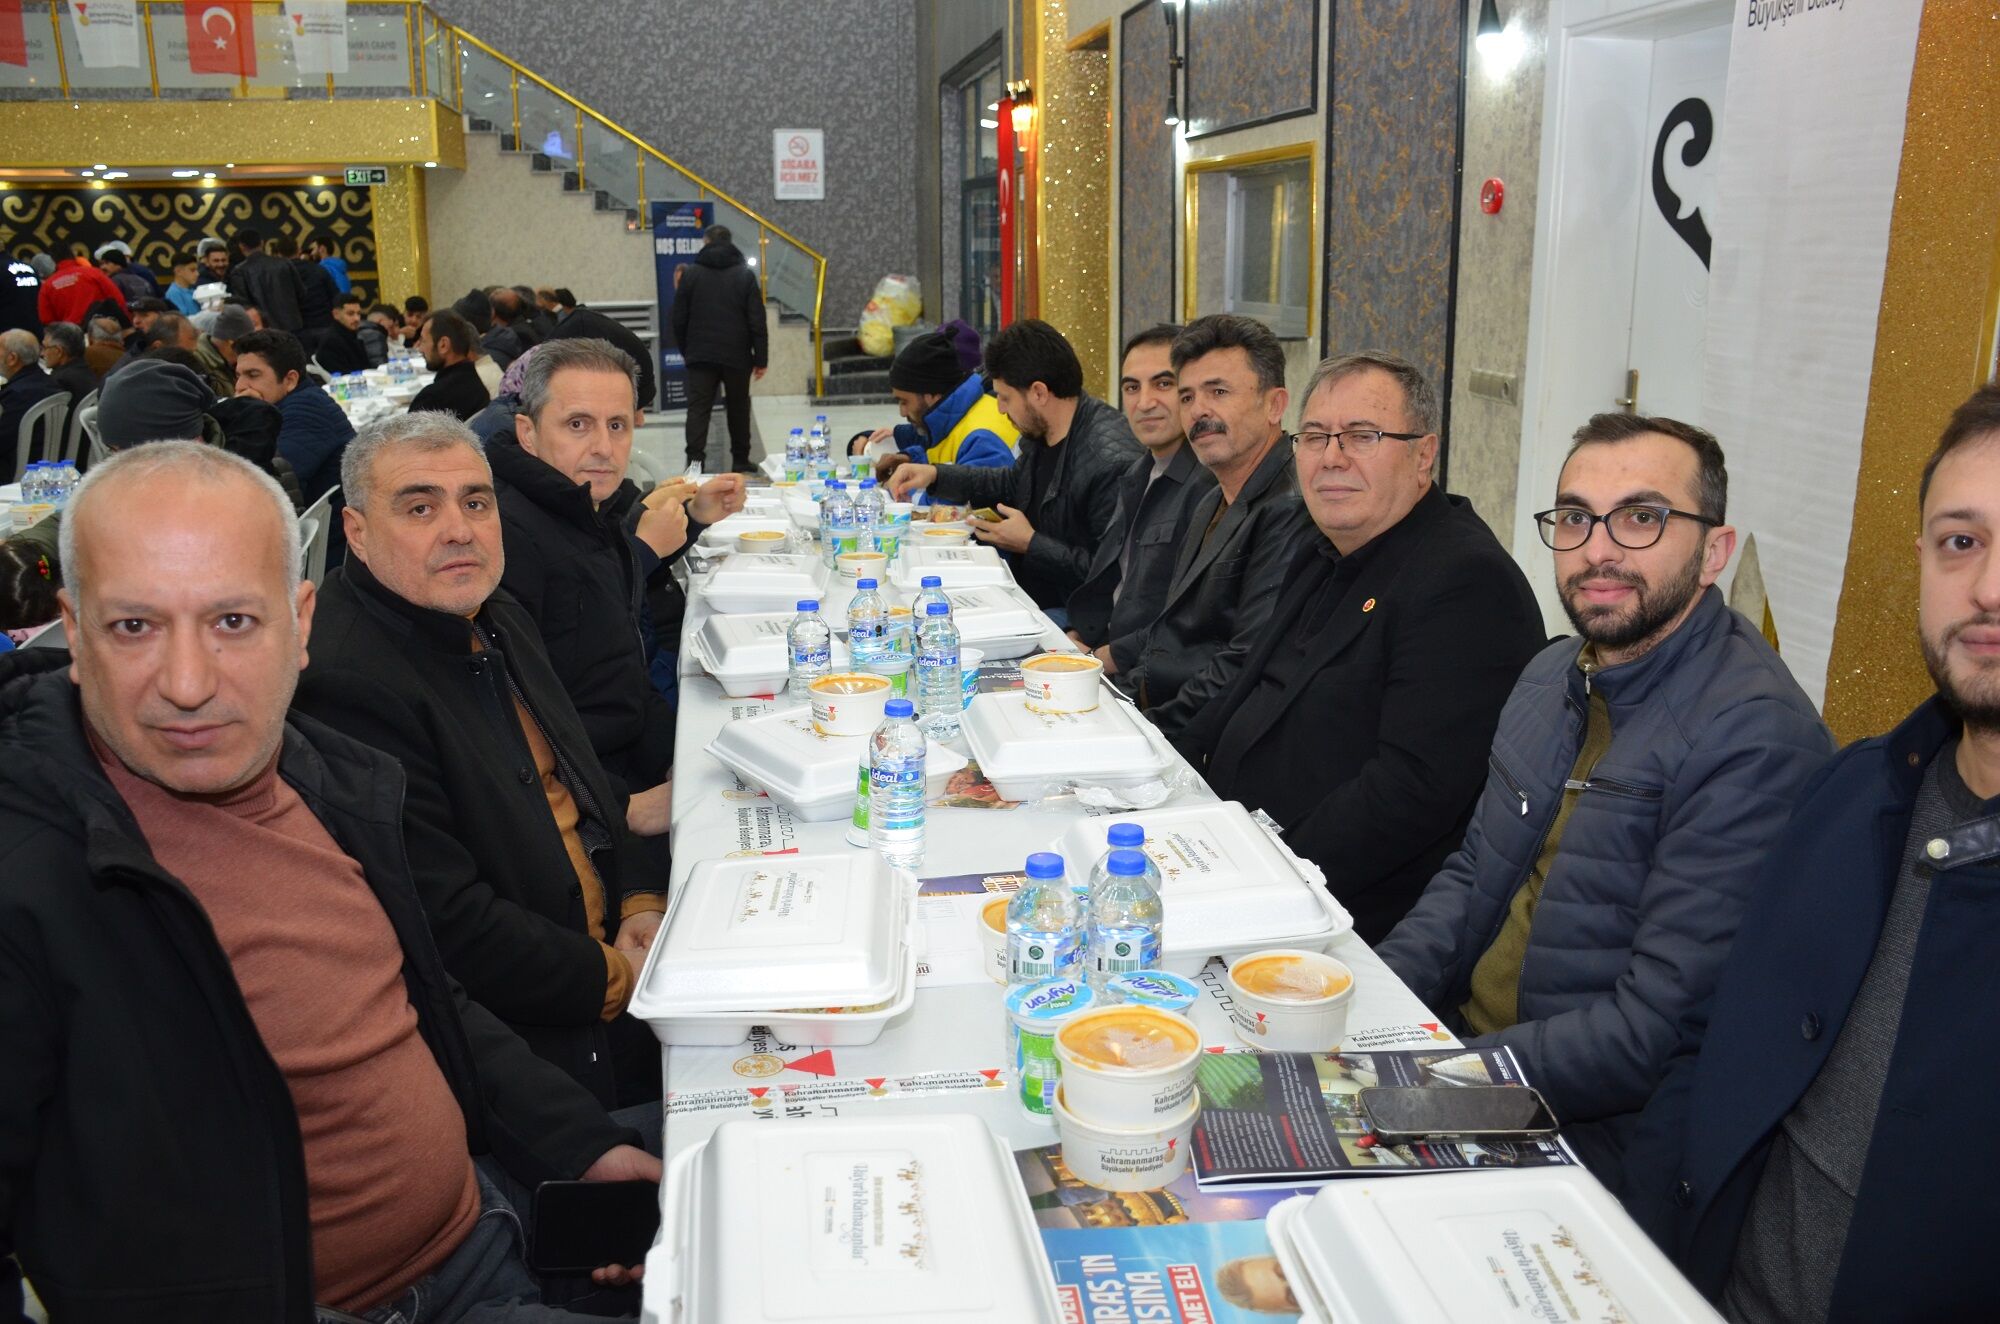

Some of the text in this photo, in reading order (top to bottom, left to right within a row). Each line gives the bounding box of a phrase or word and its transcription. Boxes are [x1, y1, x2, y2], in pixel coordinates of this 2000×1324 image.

[348, 170, 371, 184] EXIT
[807, 653, 829, 664] ideal
[918, 656, 941, 667] ideal
[871, 768, 899, 784] ideal
[1026, 983, 1076, 1010] Ayran
[783, 1086, 866, 1097] Kahramanmaraş
